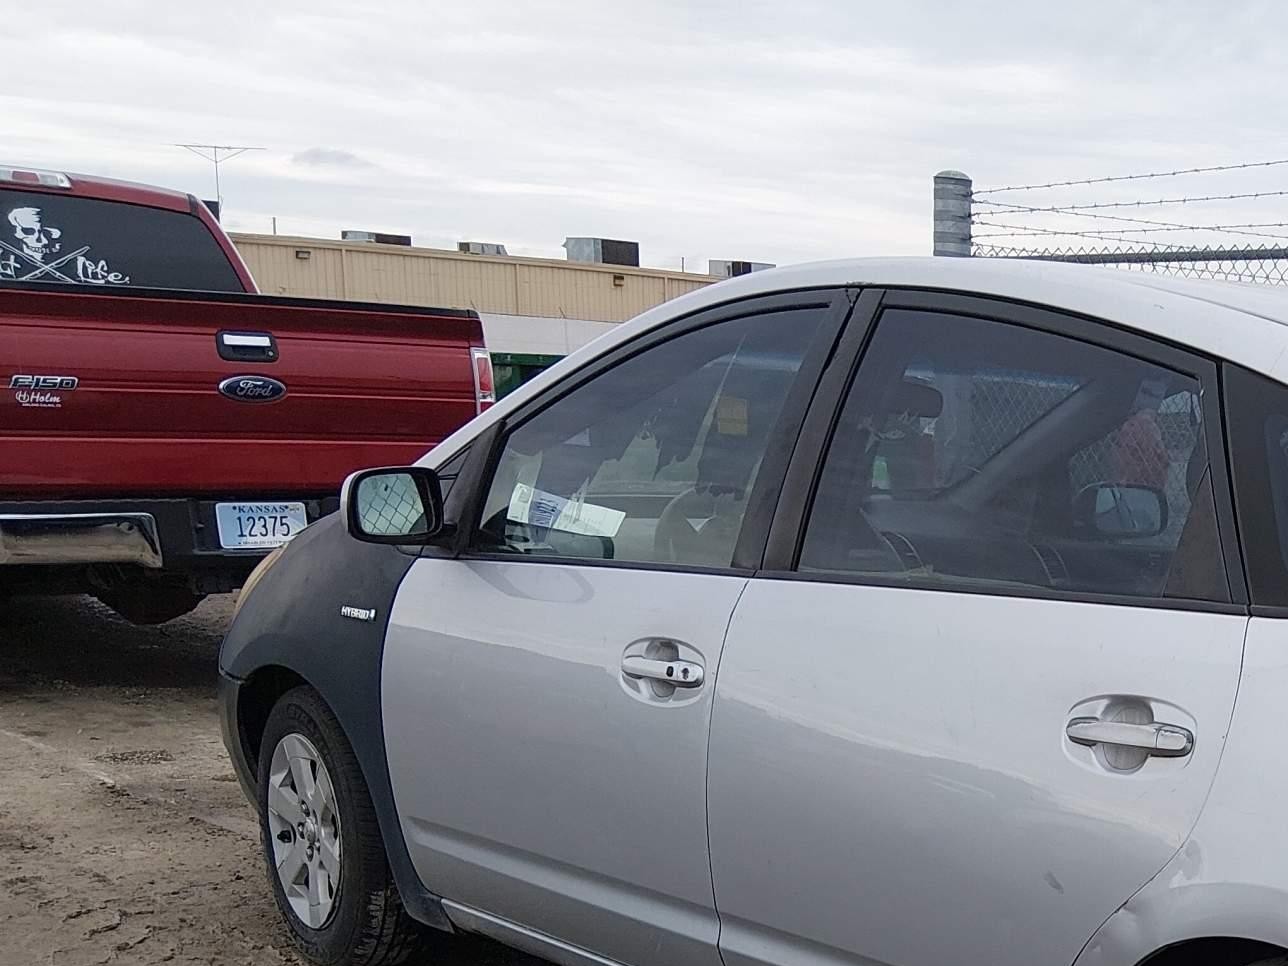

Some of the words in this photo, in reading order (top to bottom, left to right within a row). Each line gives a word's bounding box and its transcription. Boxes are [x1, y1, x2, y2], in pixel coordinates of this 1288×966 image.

[236, 380, 273, 396] Ford
[238, 505, 285, 513] KANSAS
[237, 516, 290, 537] 12375
